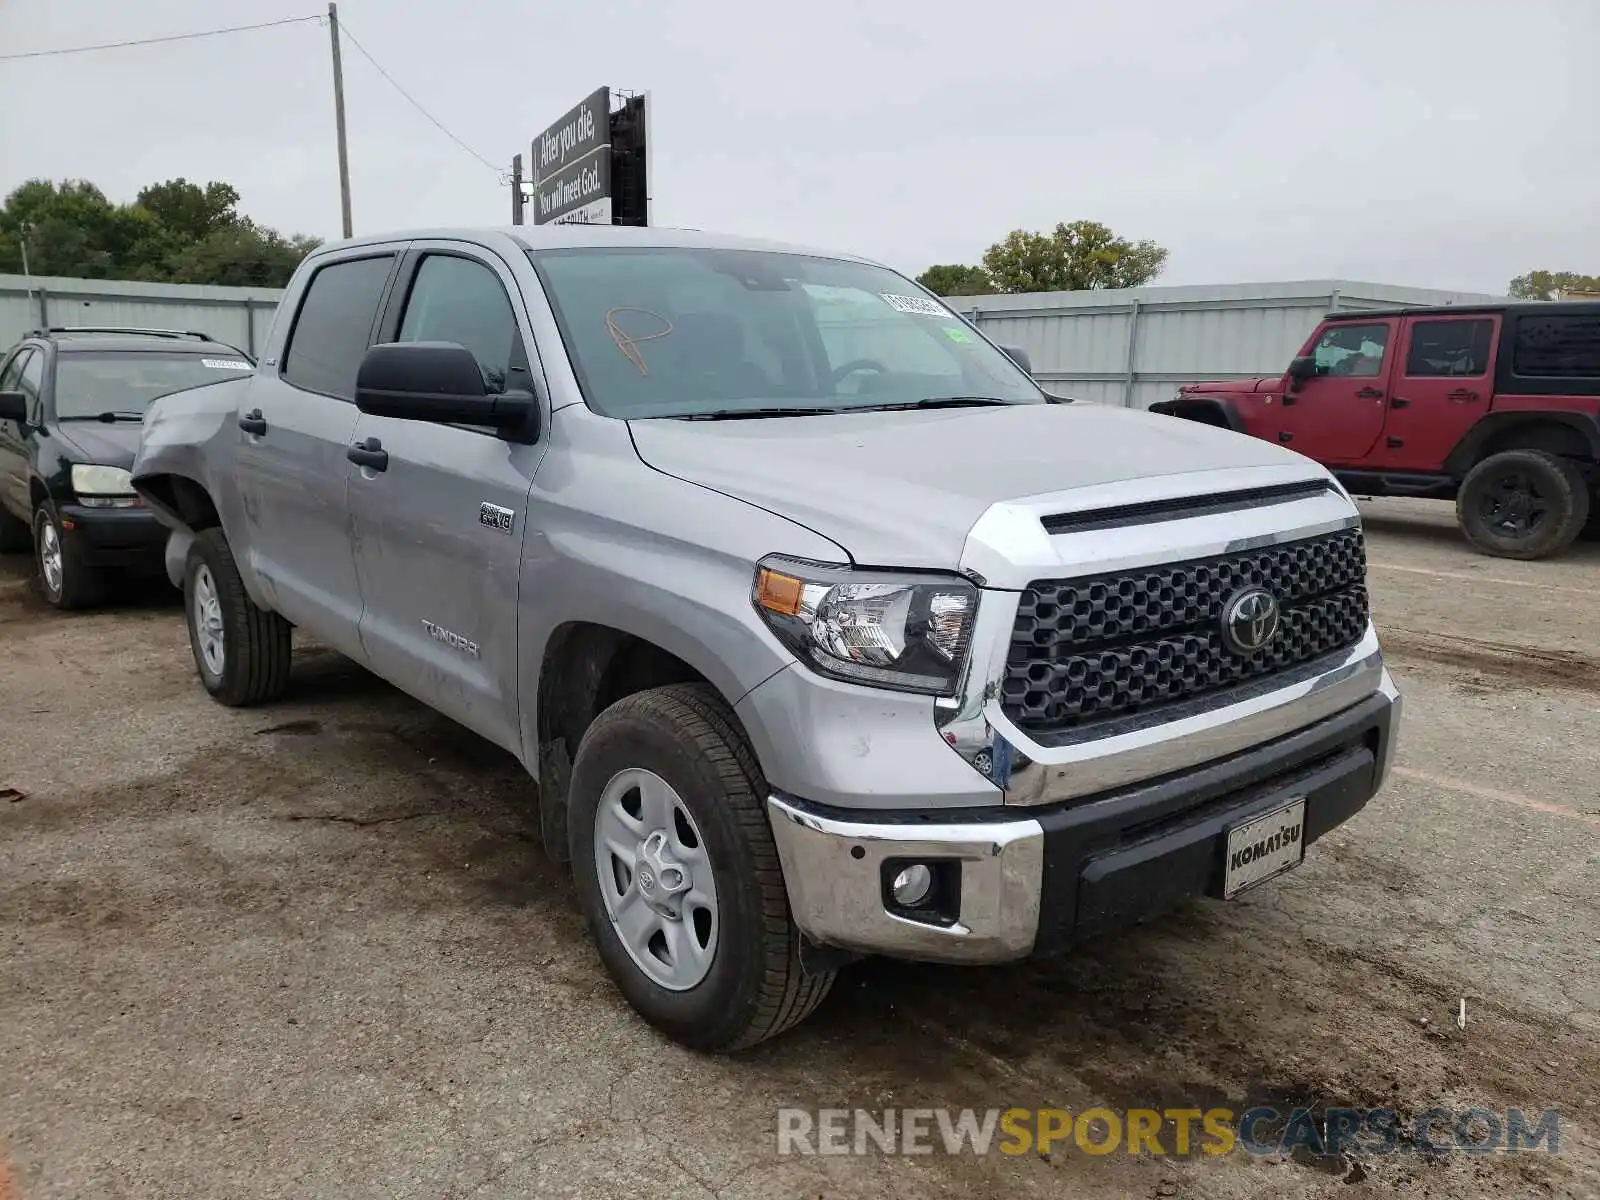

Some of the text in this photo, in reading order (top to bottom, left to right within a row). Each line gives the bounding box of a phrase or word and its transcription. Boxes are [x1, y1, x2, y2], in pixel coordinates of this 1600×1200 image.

[541, 105, 595, 168] After you die,
[540, 160, 601, 216] You will meet God.
[498, 511, 511, 530] V8
[421, 619, 478, 656] TUNDRA
[1230, 824, 1301, 872] KOMATSU
